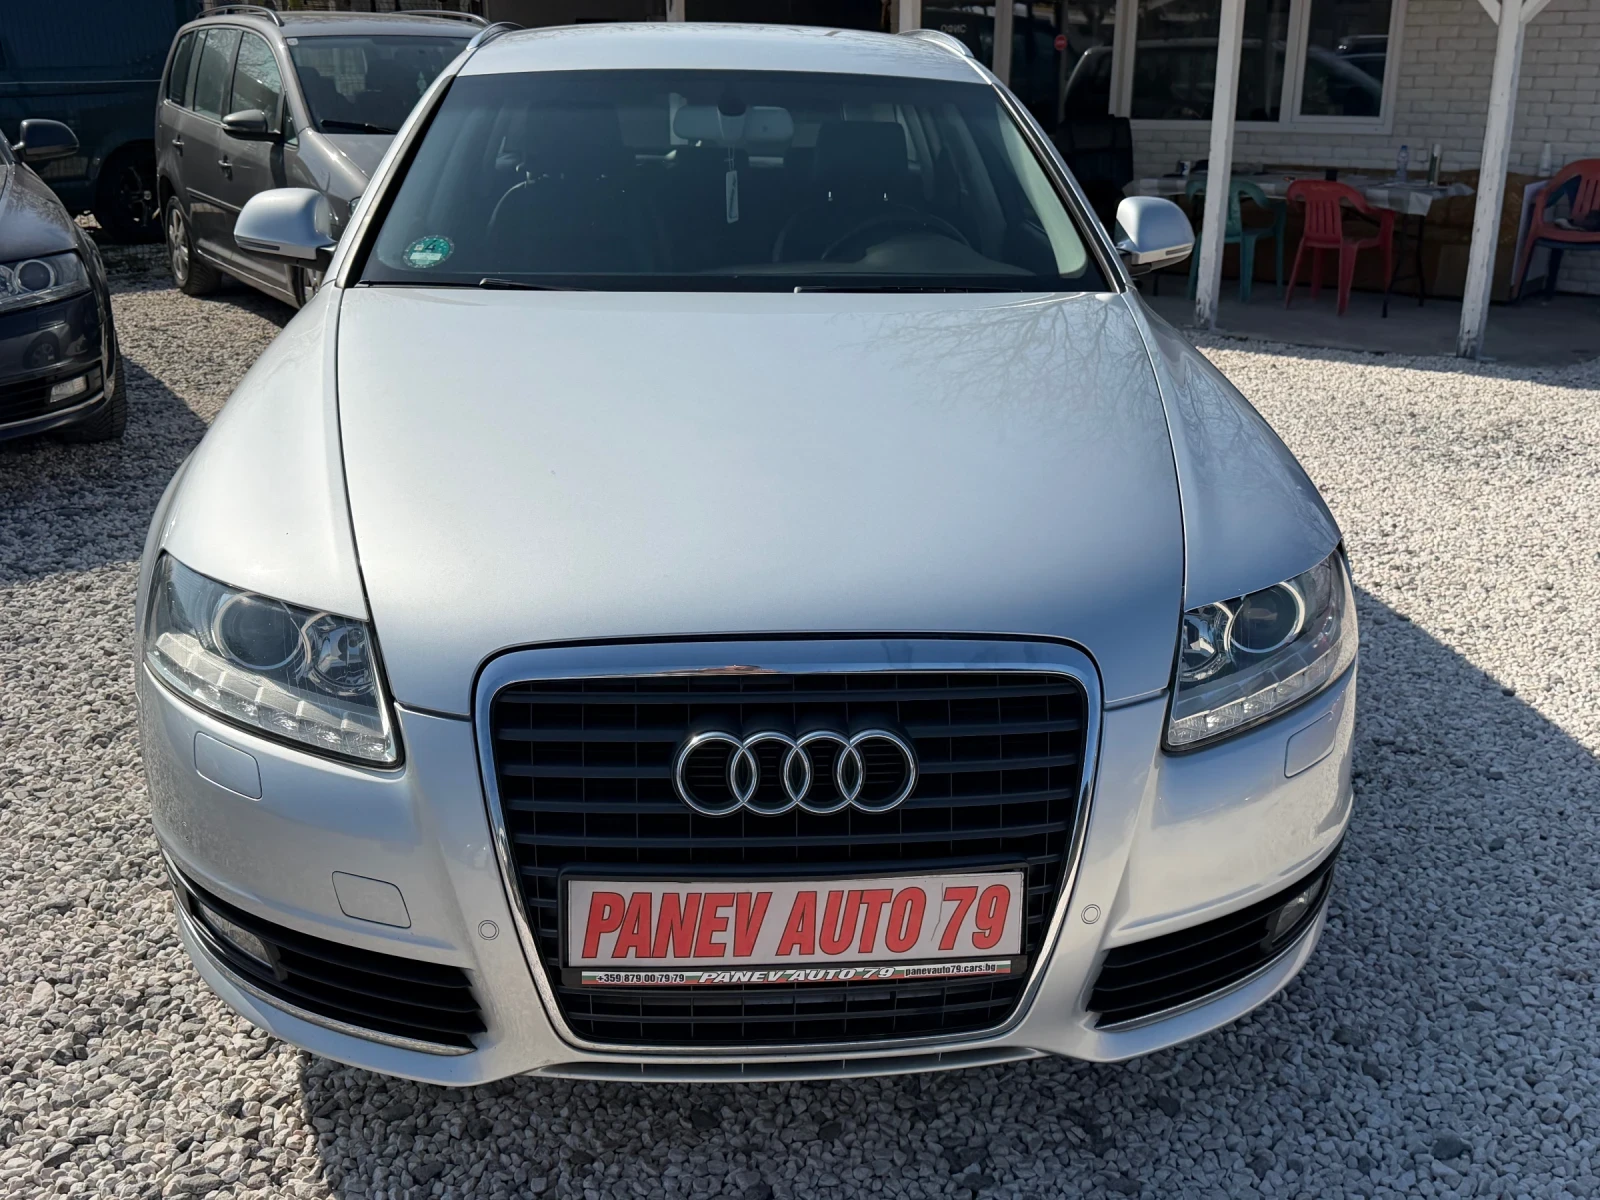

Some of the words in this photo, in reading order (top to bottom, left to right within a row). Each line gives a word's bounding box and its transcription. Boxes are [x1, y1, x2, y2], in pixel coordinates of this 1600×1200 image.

[581, 892, 773, 958] PANEV
[775, 886, 928, 957] AUTO
[938, 884, 1011, 951] 79
[699, 971, 785, 983] PANEV
[787, 967, 858, 983] AUTO
[861, 966, 896, 980] 79
[906, 963, 995, 976] panevauto79.cars.bg
[597, 973, 622, 983] +359
[624, 973, 641, 983] 879
[644, 973, 656, 983] 00
[658, 973, 670, 983] 79
[672, 973, 685, 983] 79
